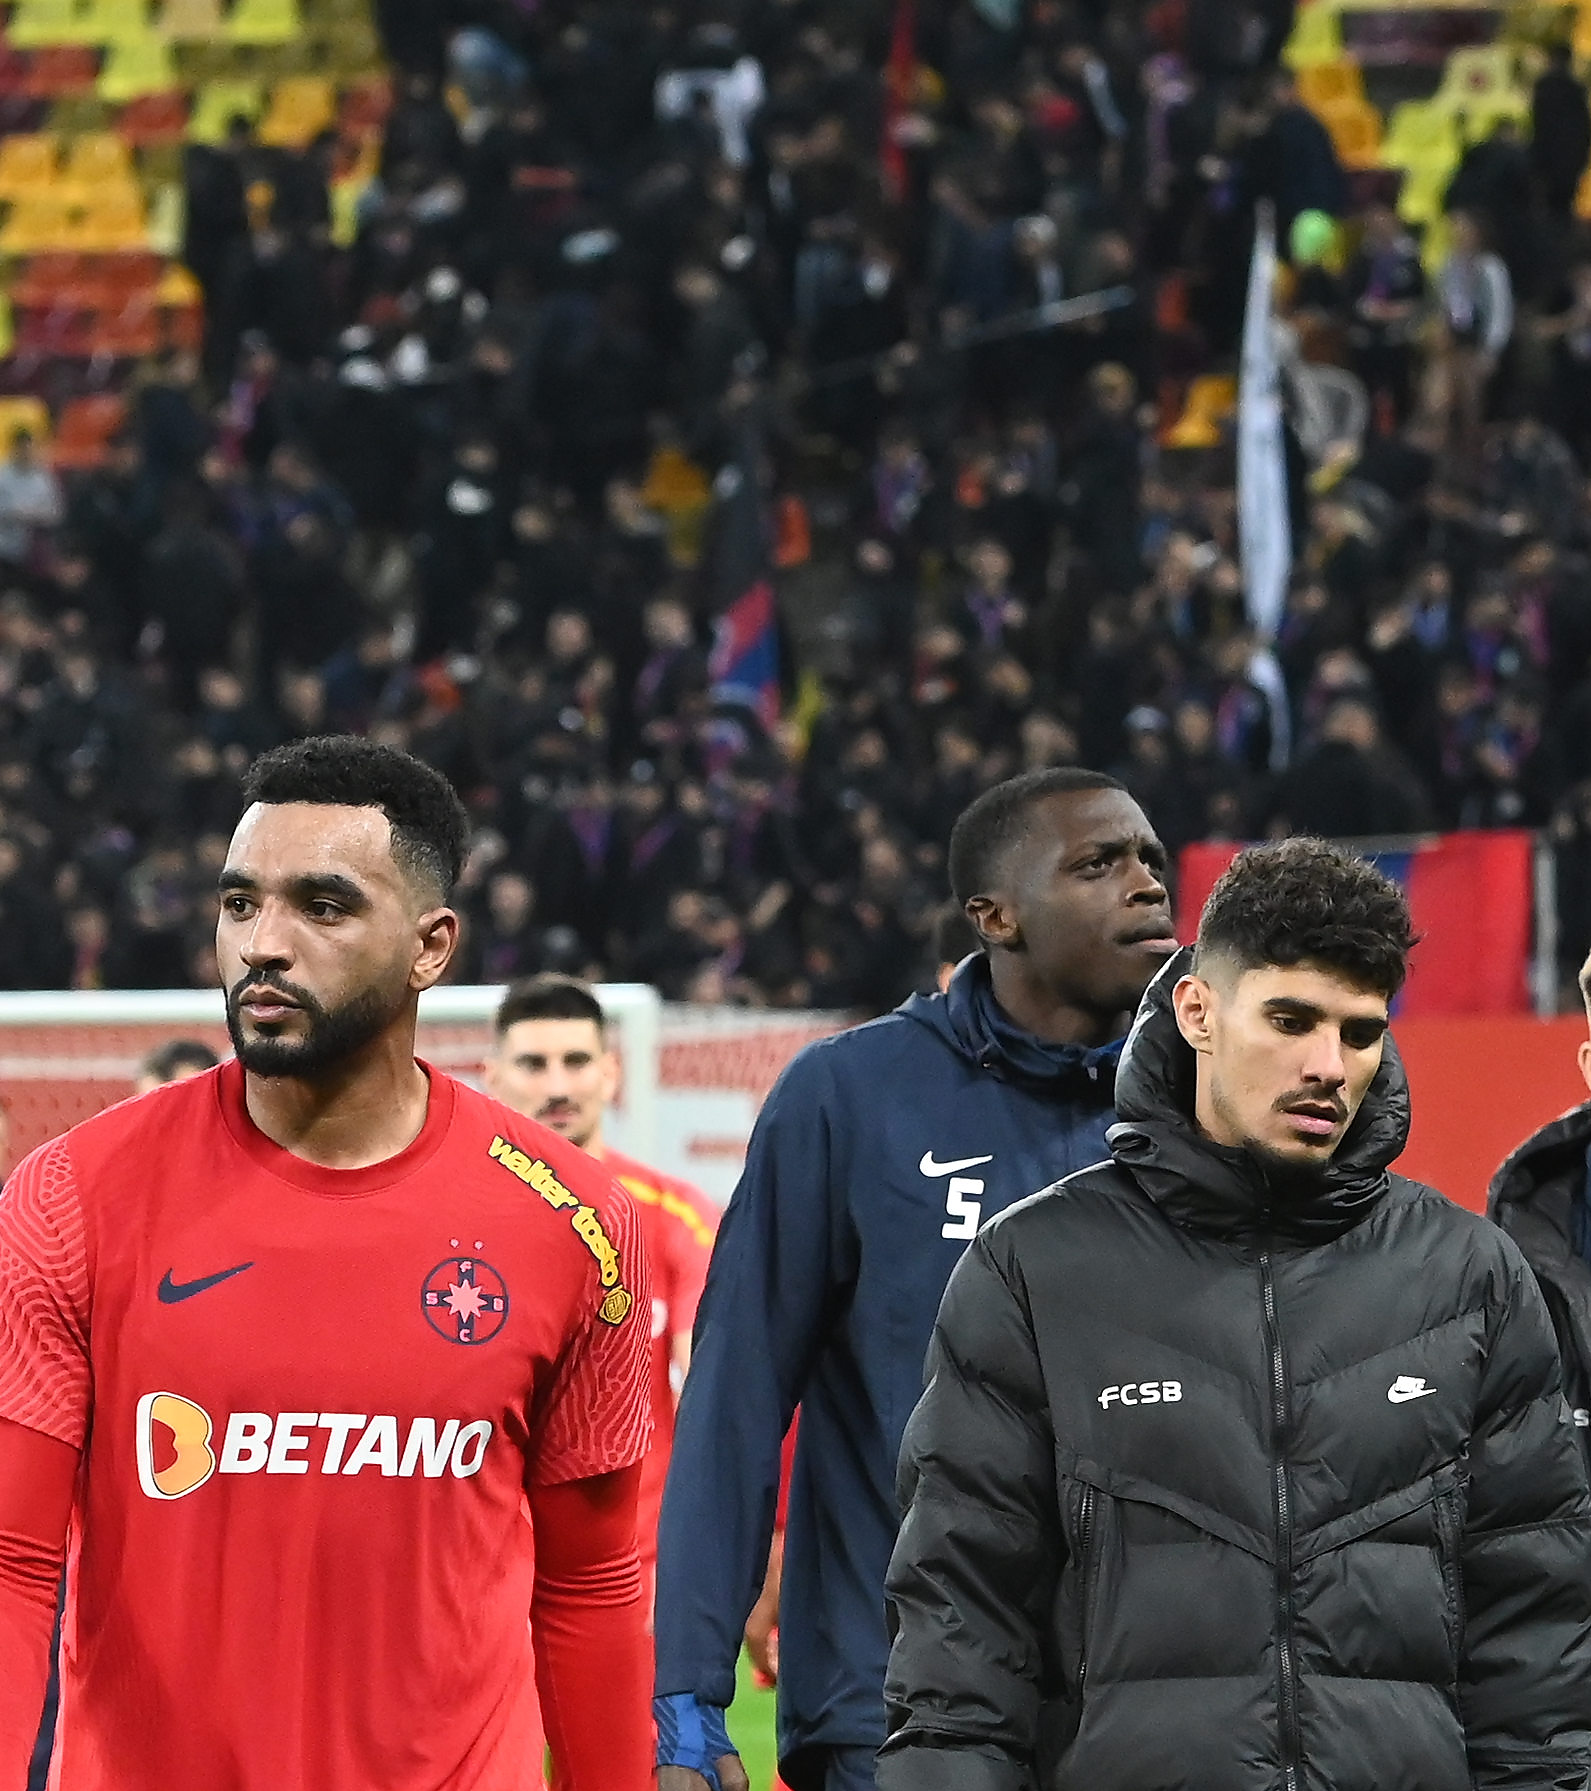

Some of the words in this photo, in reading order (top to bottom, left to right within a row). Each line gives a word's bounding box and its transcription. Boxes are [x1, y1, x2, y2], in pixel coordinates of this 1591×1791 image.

[487, 1135, 579, 1209] walter
[571, 1205, 619, 1287] tosto
[941, 1177, 985, 1240] 5
[1097, 1380, 1183, 1410] FCSB
[218, 1412, 493, 1479] BETANO
